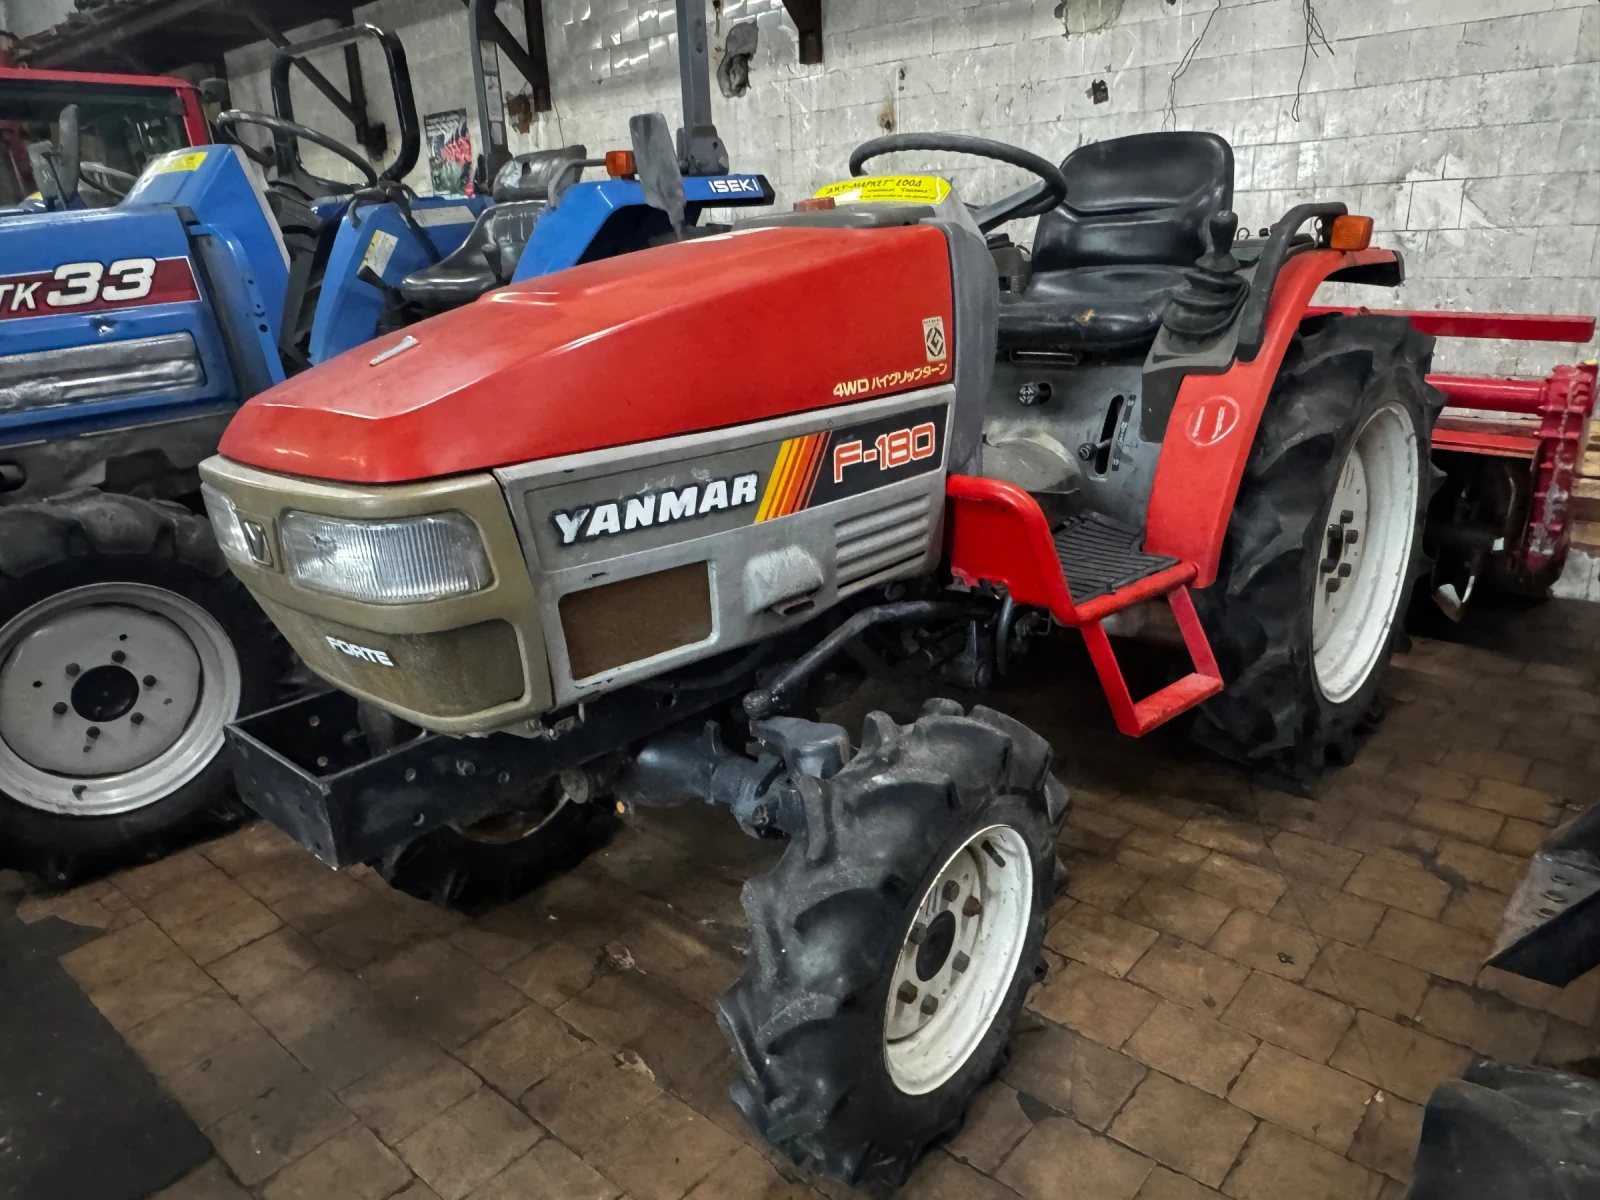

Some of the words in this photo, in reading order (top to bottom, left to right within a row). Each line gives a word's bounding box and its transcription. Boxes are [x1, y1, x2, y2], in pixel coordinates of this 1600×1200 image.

[708, 178, 759, 193] ISEKI
[46, 257, 157, 307] 33
[833, 378, 870, 397] 4WD
[833, 421, 936, 484] F-180
[553, 472, 759, 545] YANMAR
[325, 635, 395, 667] FORTE
